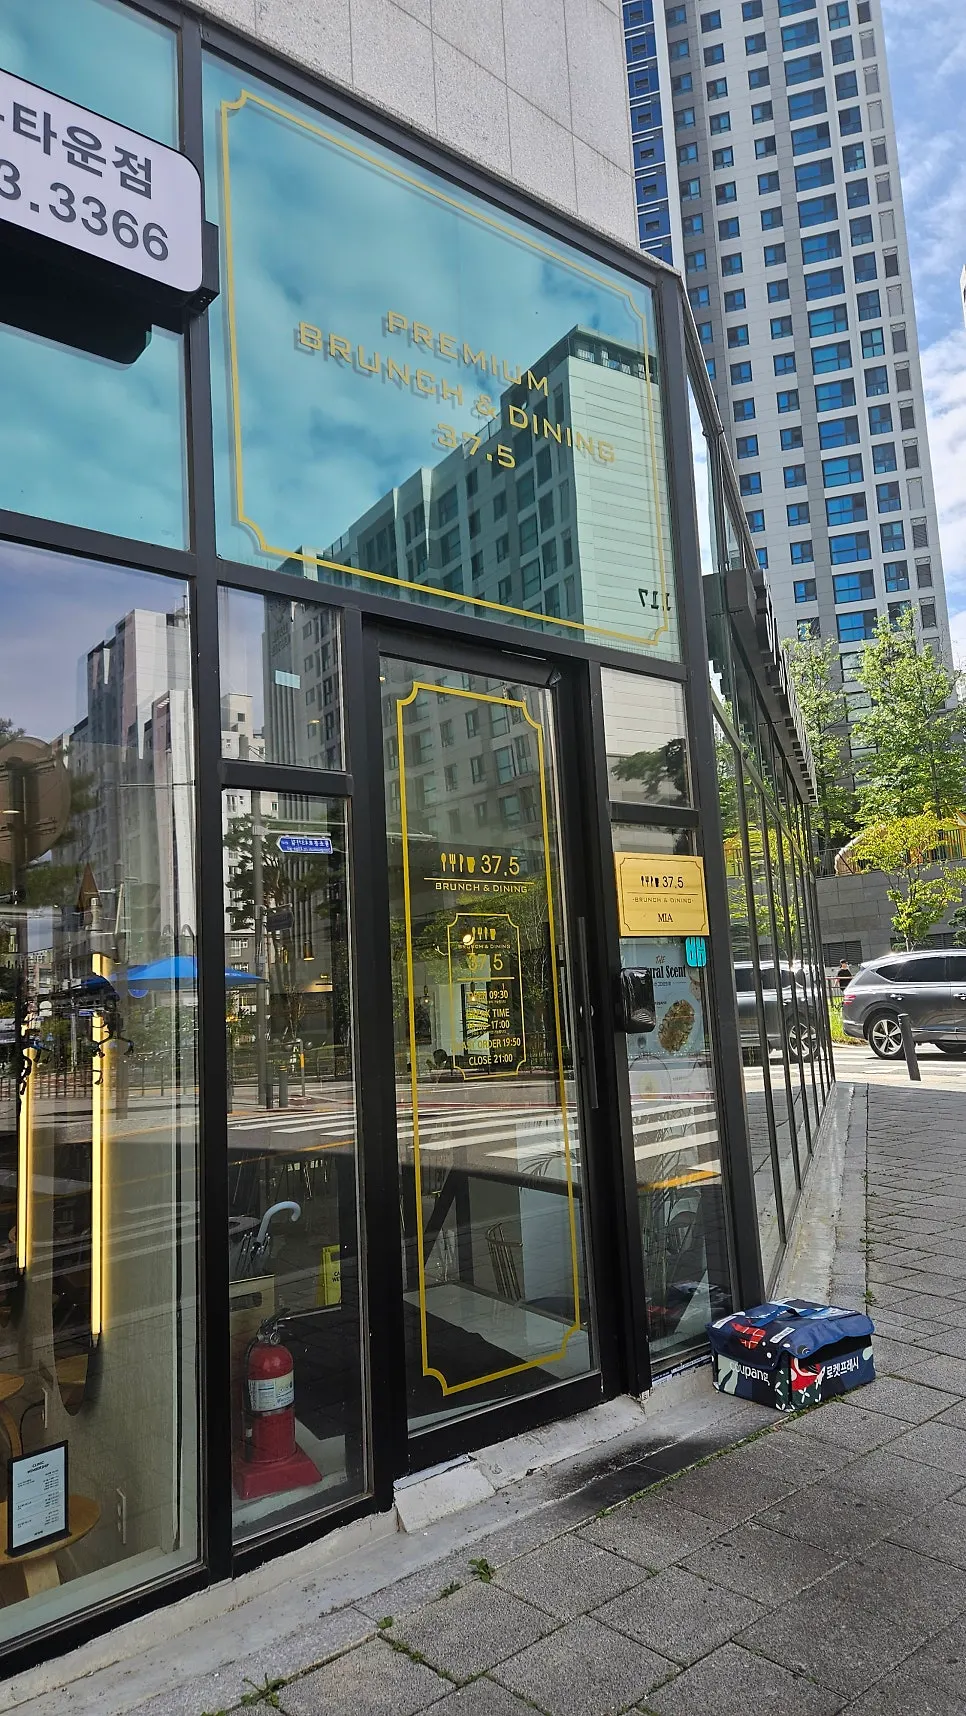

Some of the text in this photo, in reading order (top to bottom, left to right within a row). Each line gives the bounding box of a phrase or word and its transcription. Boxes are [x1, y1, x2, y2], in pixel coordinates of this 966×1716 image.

[0, 102, 152, 199] 타운점
[387, 310, 549, 396] PREMIUM
[298, 322, 615, 463] BRUNCH & DINING
[437, 423, 516, 469] 37.5
[480, 854, 520, 877] 37.5
[435, 882, 528, 893] BRUNCH & DINING
[662, 875, 684, 889] 37.5
[657, 912, 674, 923] MIA
[665, 964, 687, 979] Scent
[489, 990, 509, 1000] 09:30
[492, 1008, 510, 1018] TIME
[478, 1039, 502, 1049] ORDER
[502, 1037, 521, 1048] 19:50
[469, 1053, 513, 1066] CLOSE 21:00
[729, 1360, 771, 1387] coupang
[826, 1357, 859, 1380] 로켓프레시
